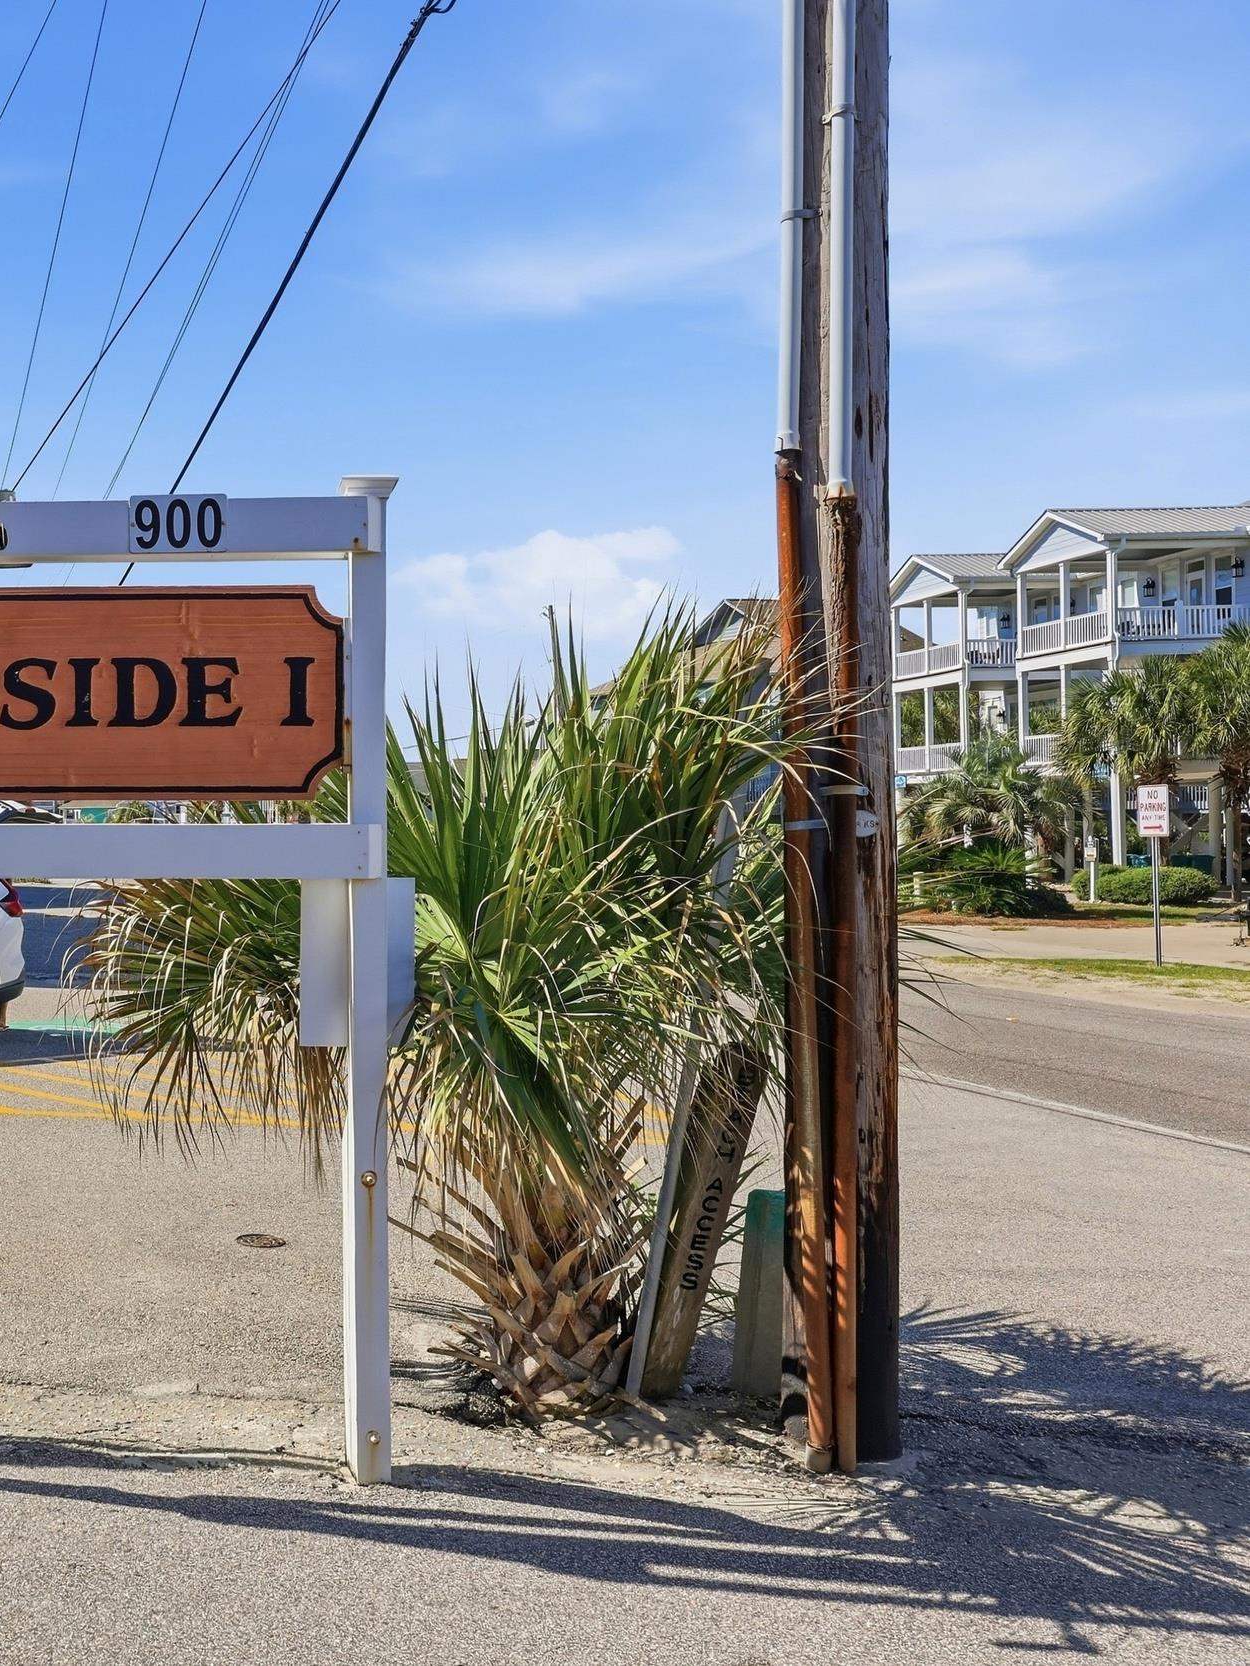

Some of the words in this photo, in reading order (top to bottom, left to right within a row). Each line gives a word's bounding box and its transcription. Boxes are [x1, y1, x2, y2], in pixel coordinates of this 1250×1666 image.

[134, 498, 222, 549] 900
[279, 656, 316, 727] I
[1140, 802, 1166, 811] PARKING
[1147, 790, 1159, 799] NO
[681, 1177, 723, 1290] ACCESS
